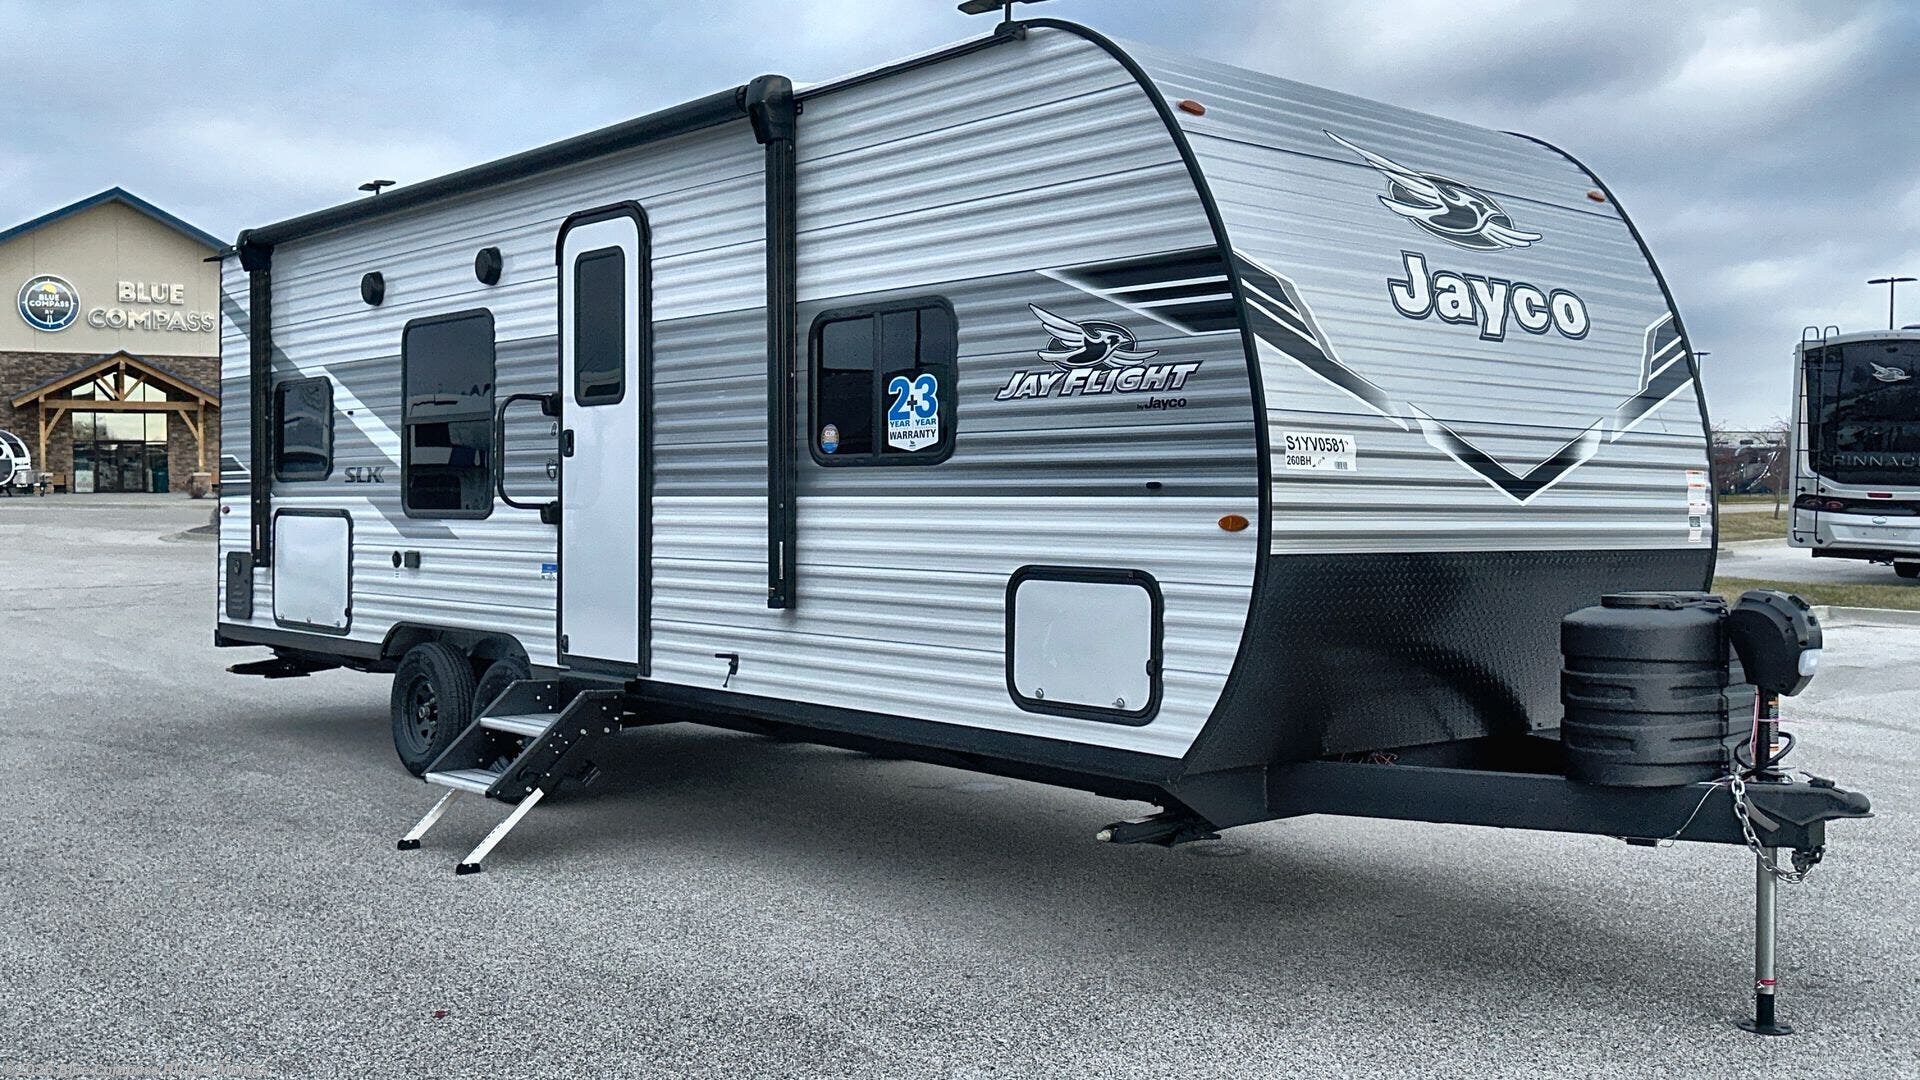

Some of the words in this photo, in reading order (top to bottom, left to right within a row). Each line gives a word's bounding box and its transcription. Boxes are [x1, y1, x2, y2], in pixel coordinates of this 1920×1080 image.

[117, 281, 184, 305] BLUE
[1387, 250, 1591, 342] Jayco
[28, 300, 70, 308] COMPASS
[87, 307, 216, 332] COMPASS
[994, 370, 1066, 400] JAY
[1058, 360, 1204, 397] FLIGHT
[1144, 397, 1187, 410] Jayco
[890, 420, 911, 428] YEAR
[915, 418, 937, 426] YEAR
[889, 429, 937, 440] WARRANTY
[1286, 435, 1345, 453] S1YV0581
[1286, 455, 1311, 466] 260BH
[344, 466, 385, 483] SLK
